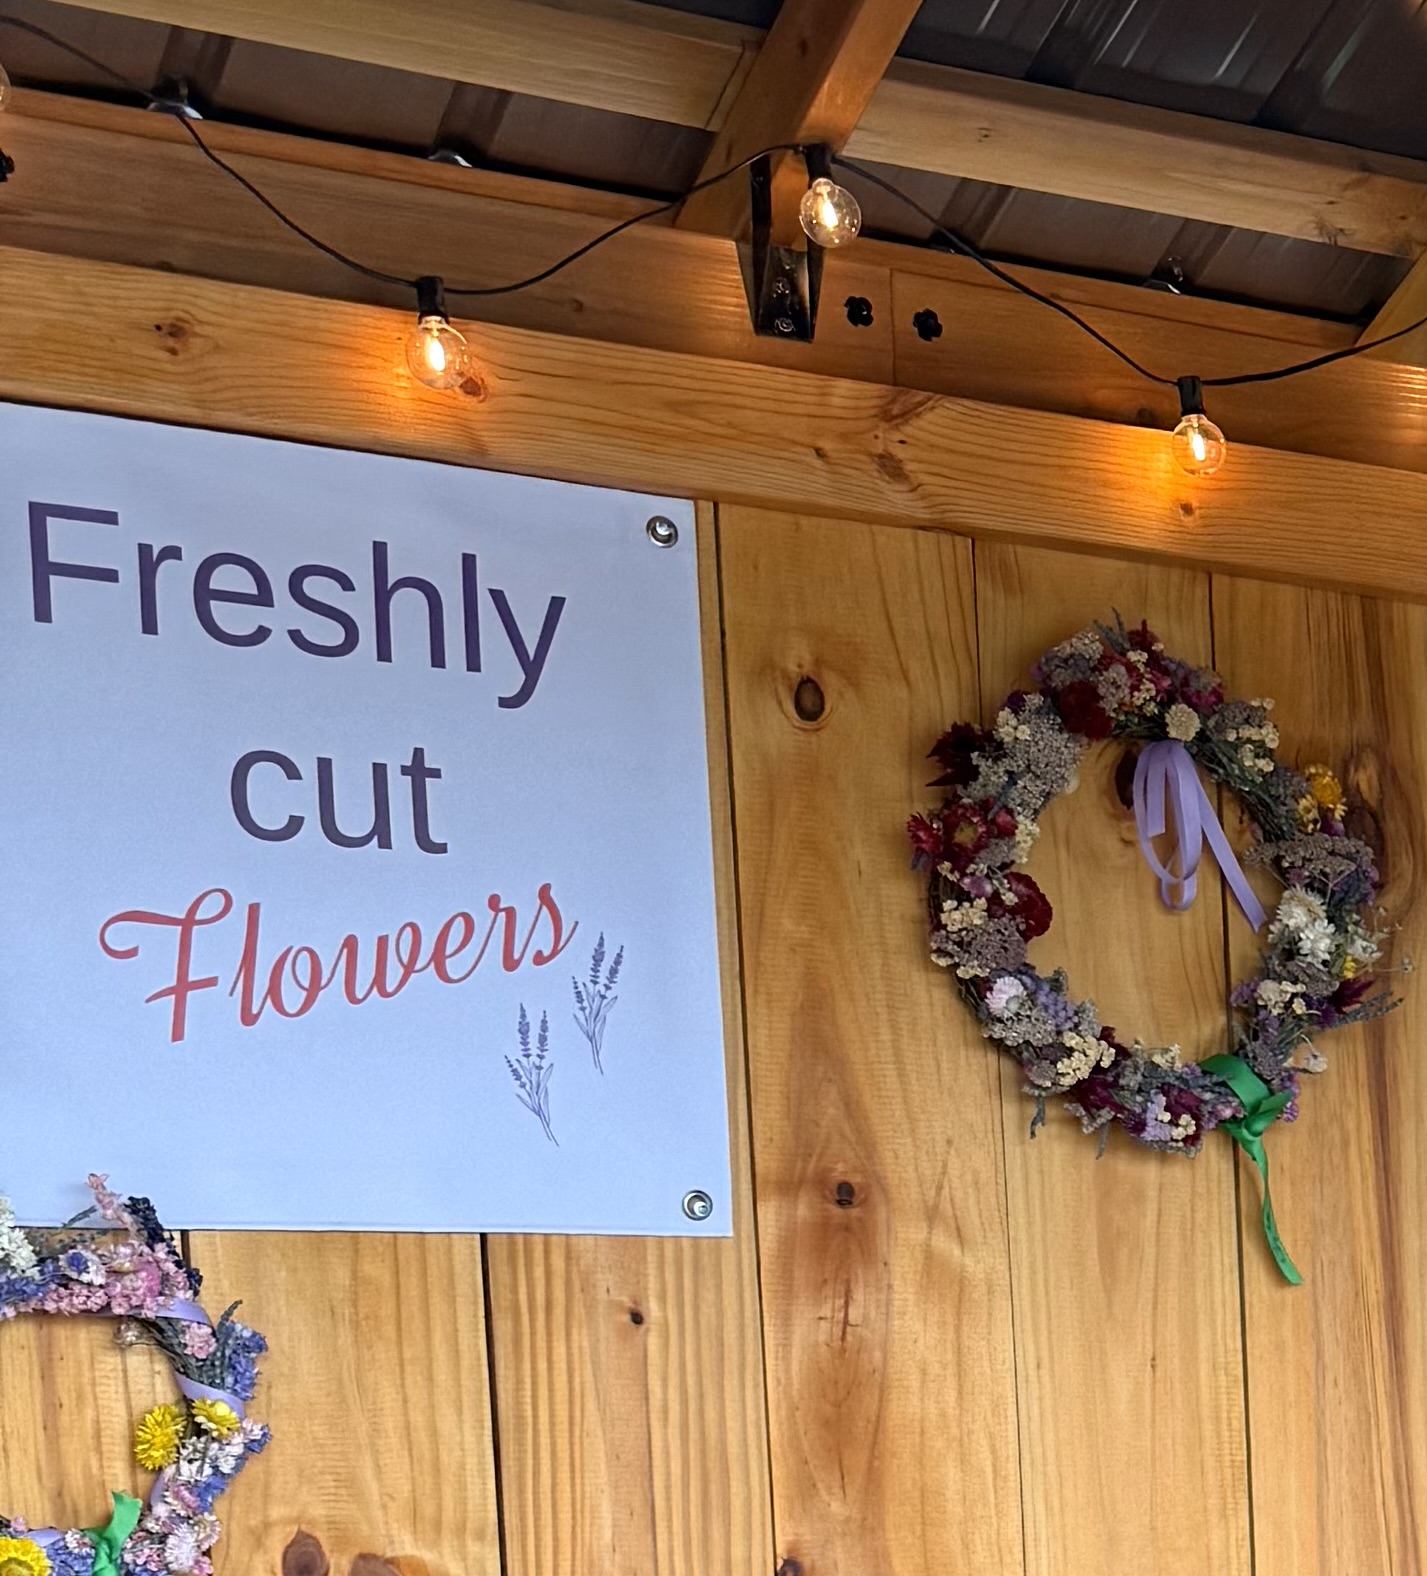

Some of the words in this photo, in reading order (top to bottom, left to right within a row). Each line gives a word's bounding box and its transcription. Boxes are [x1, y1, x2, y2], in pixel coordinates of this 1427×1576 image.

[26, 500, 566, 709] Freshly
[230, 745, 448, 854] cut
[98, 882, 579, 1043] Flowers
